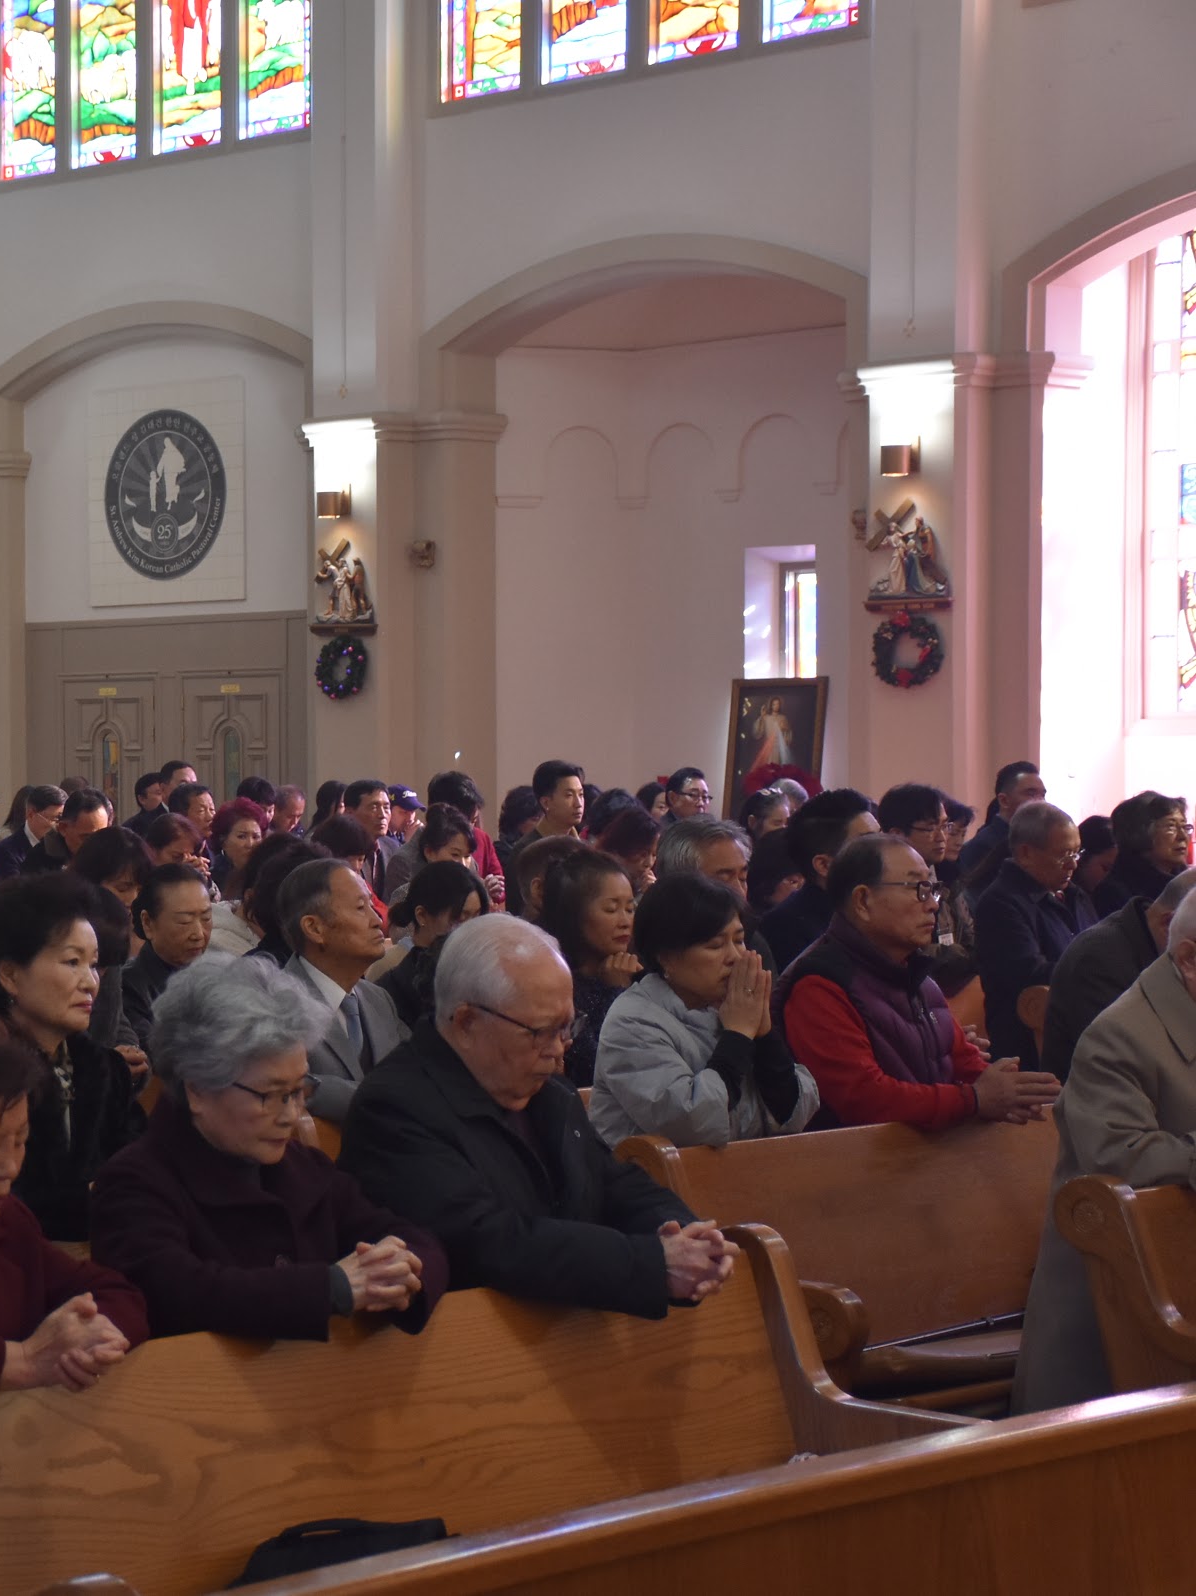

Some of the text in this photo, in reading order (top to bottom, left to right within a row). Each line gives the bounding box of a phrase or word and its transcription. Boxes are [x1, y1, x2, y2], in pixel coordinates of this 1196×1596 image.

[111, 519, 128, 551] Andrew
[126, 547, 140, 565] Kim
[139, 559, 164, 574] Korean
[164, 557, 193, 574] Catholic
[191, 528, 214, 560] Pastoral
[209, 497, 221, 528] Center
[157, 524, 172, 540] 25
